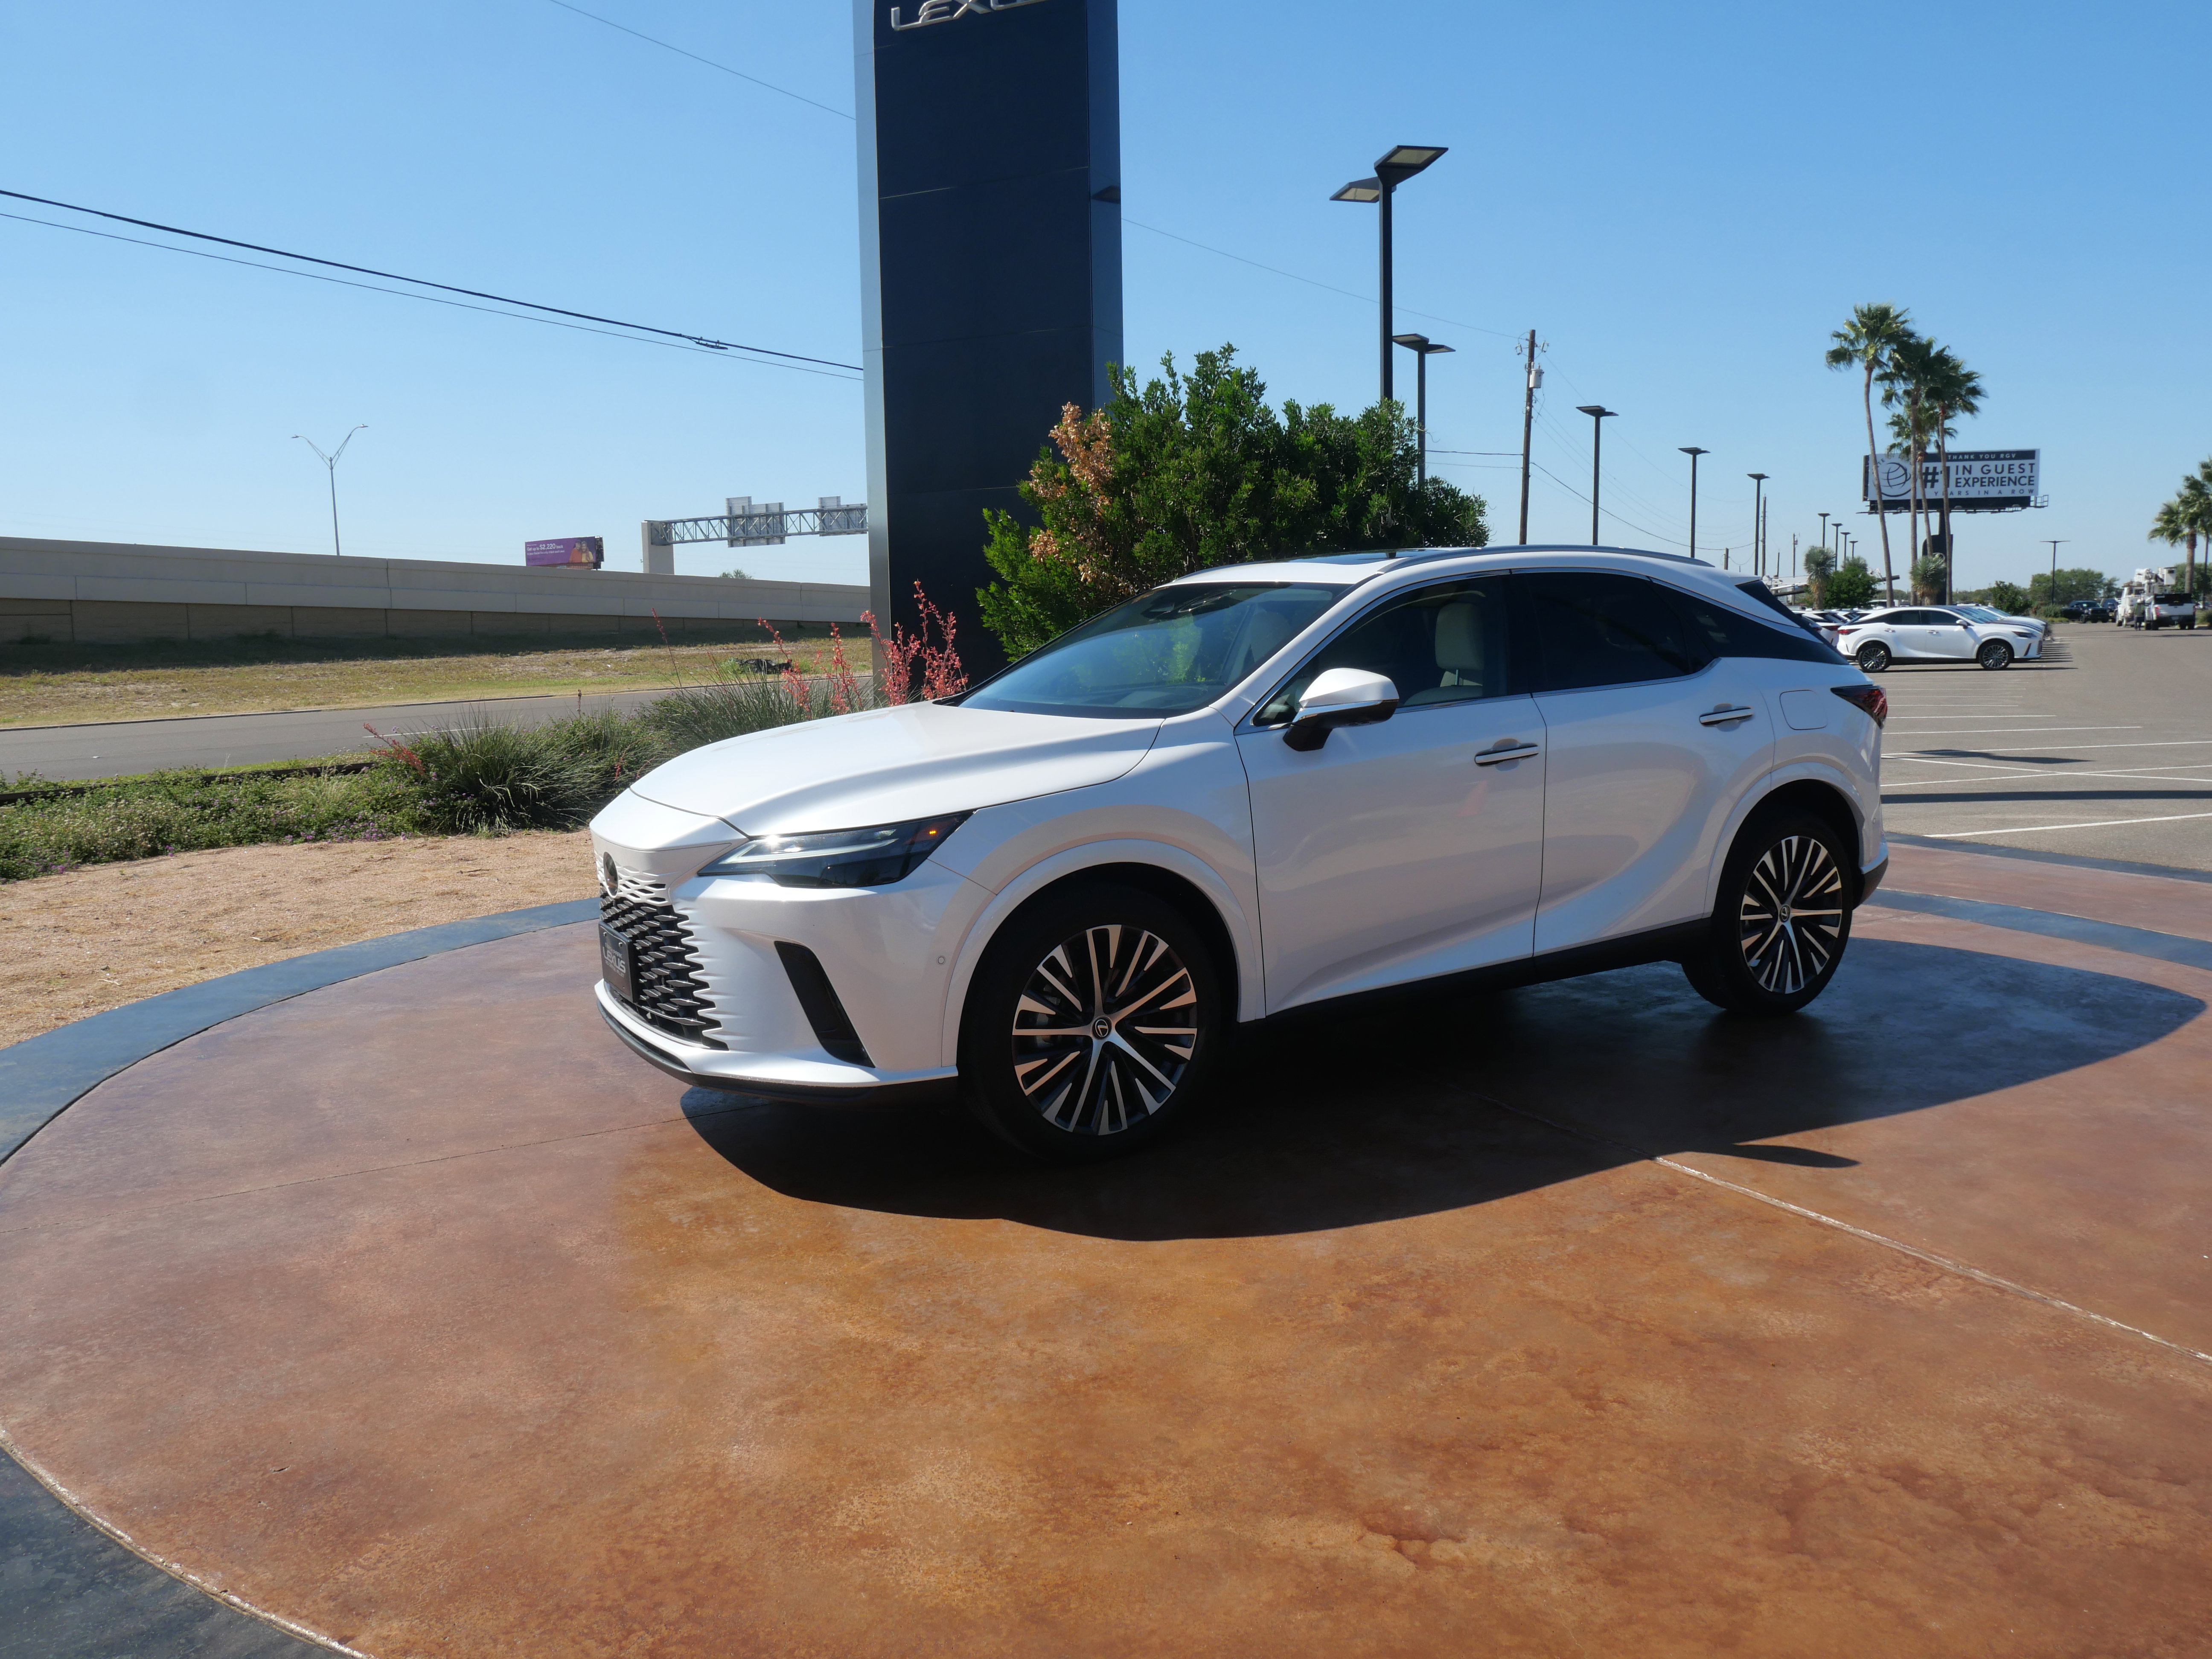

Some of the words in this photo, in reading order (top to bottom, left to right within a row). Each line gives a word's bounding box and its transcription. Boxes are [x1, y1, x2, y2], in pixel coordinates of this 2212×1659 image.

[1956, 465, 1972, 475] IN
[1980, 463, 2035, 474] GUEST
[1955, 475, 2035, 488] EXPERIENCE
[603, 946, 626, 973] LEXUS
